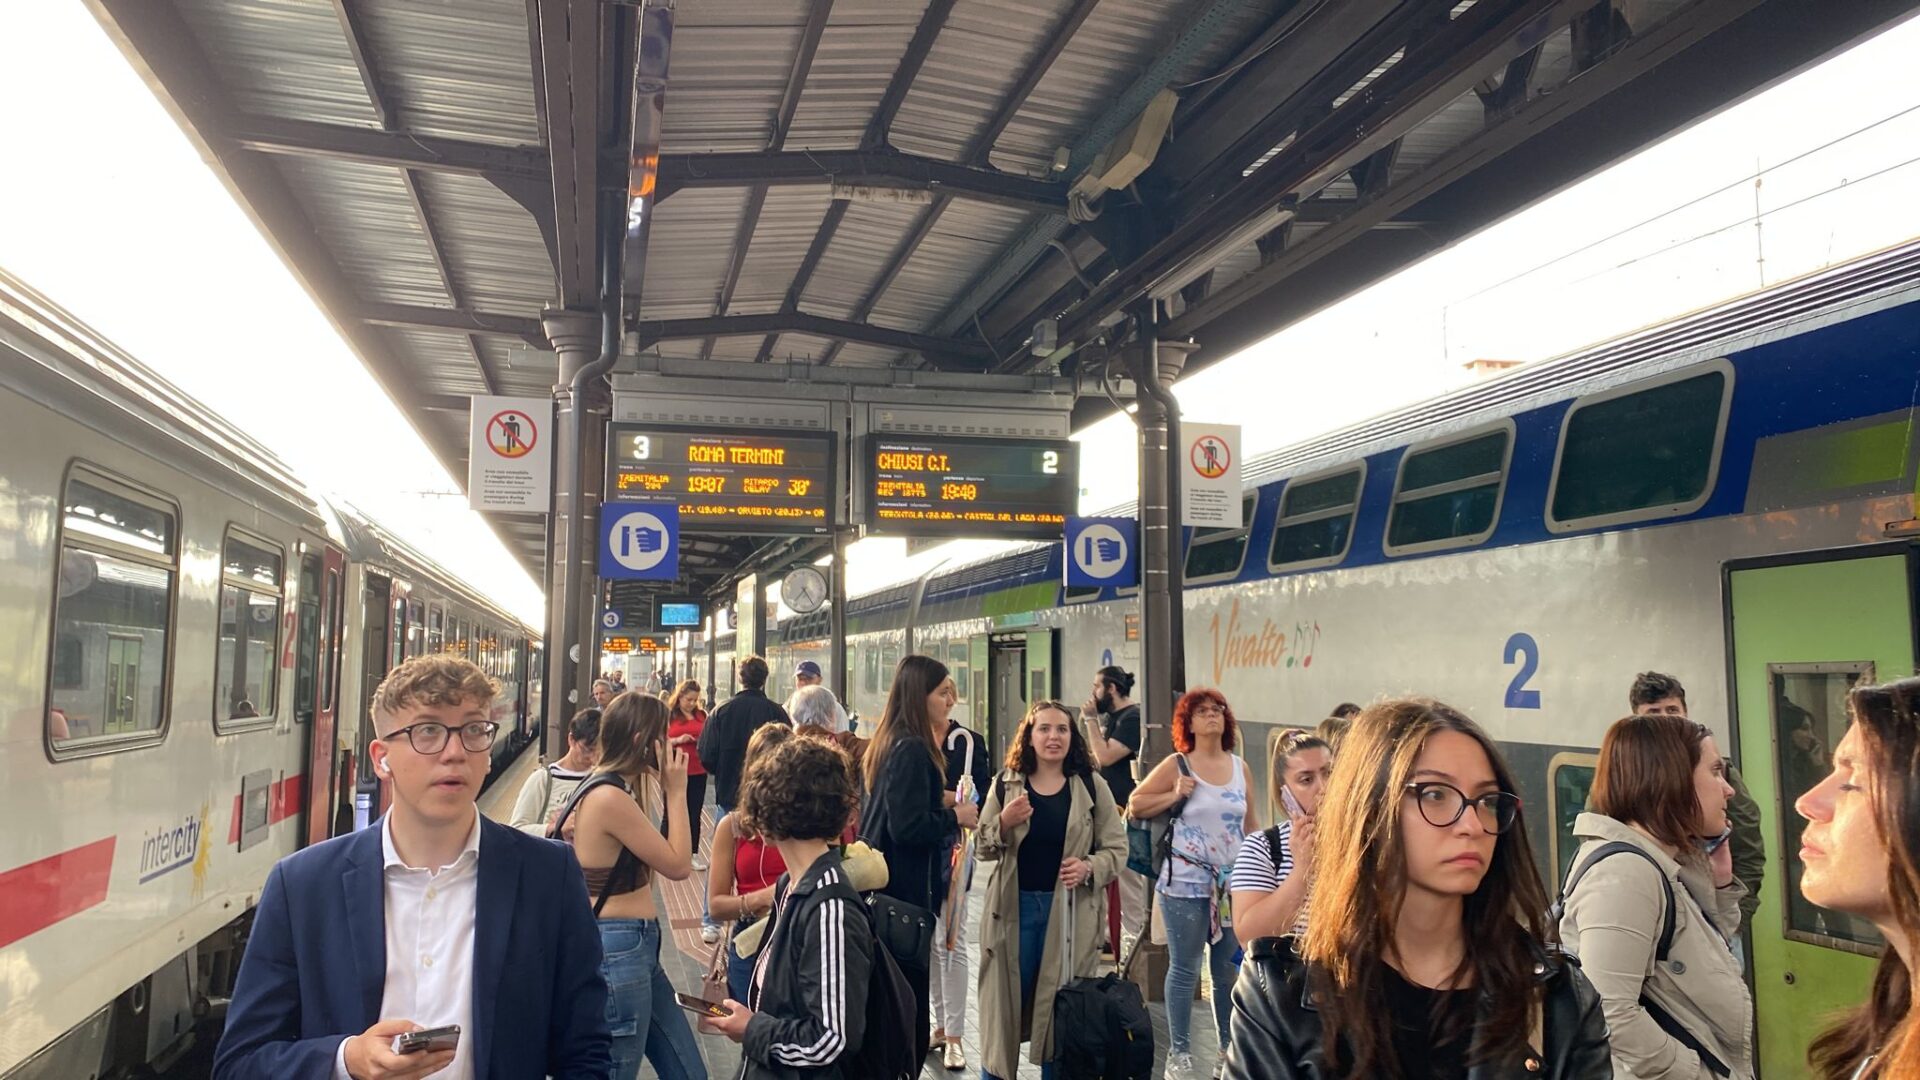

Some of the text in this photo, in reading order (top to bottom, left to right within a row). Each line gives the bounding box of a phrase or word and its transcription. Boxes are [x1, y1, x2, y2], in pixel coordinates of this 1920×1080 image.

[633, 435, 649, 459] 3
[689, 446, 784, 465] ROMA TERMINI
[879, 453, 950, 471] CHIUSI C.T.
[1043, 451, 1057, 473] 2
[619, 474, 669, 483] TRENITALIA
[688, 476, 725, 493] 19:07
[942, 484, 976, 500] 19:40
[738, 507, 772, 515] ORVIETO
[813, 509, 825, 517] OR
[607, 614, 615, 625] 3
[283, 612, 296, 668] 2
[1209, 598, 1288, 686] Vivalto
[1503, 632, 1541, 709] 2
[140, 815, 201, 873] intercity
